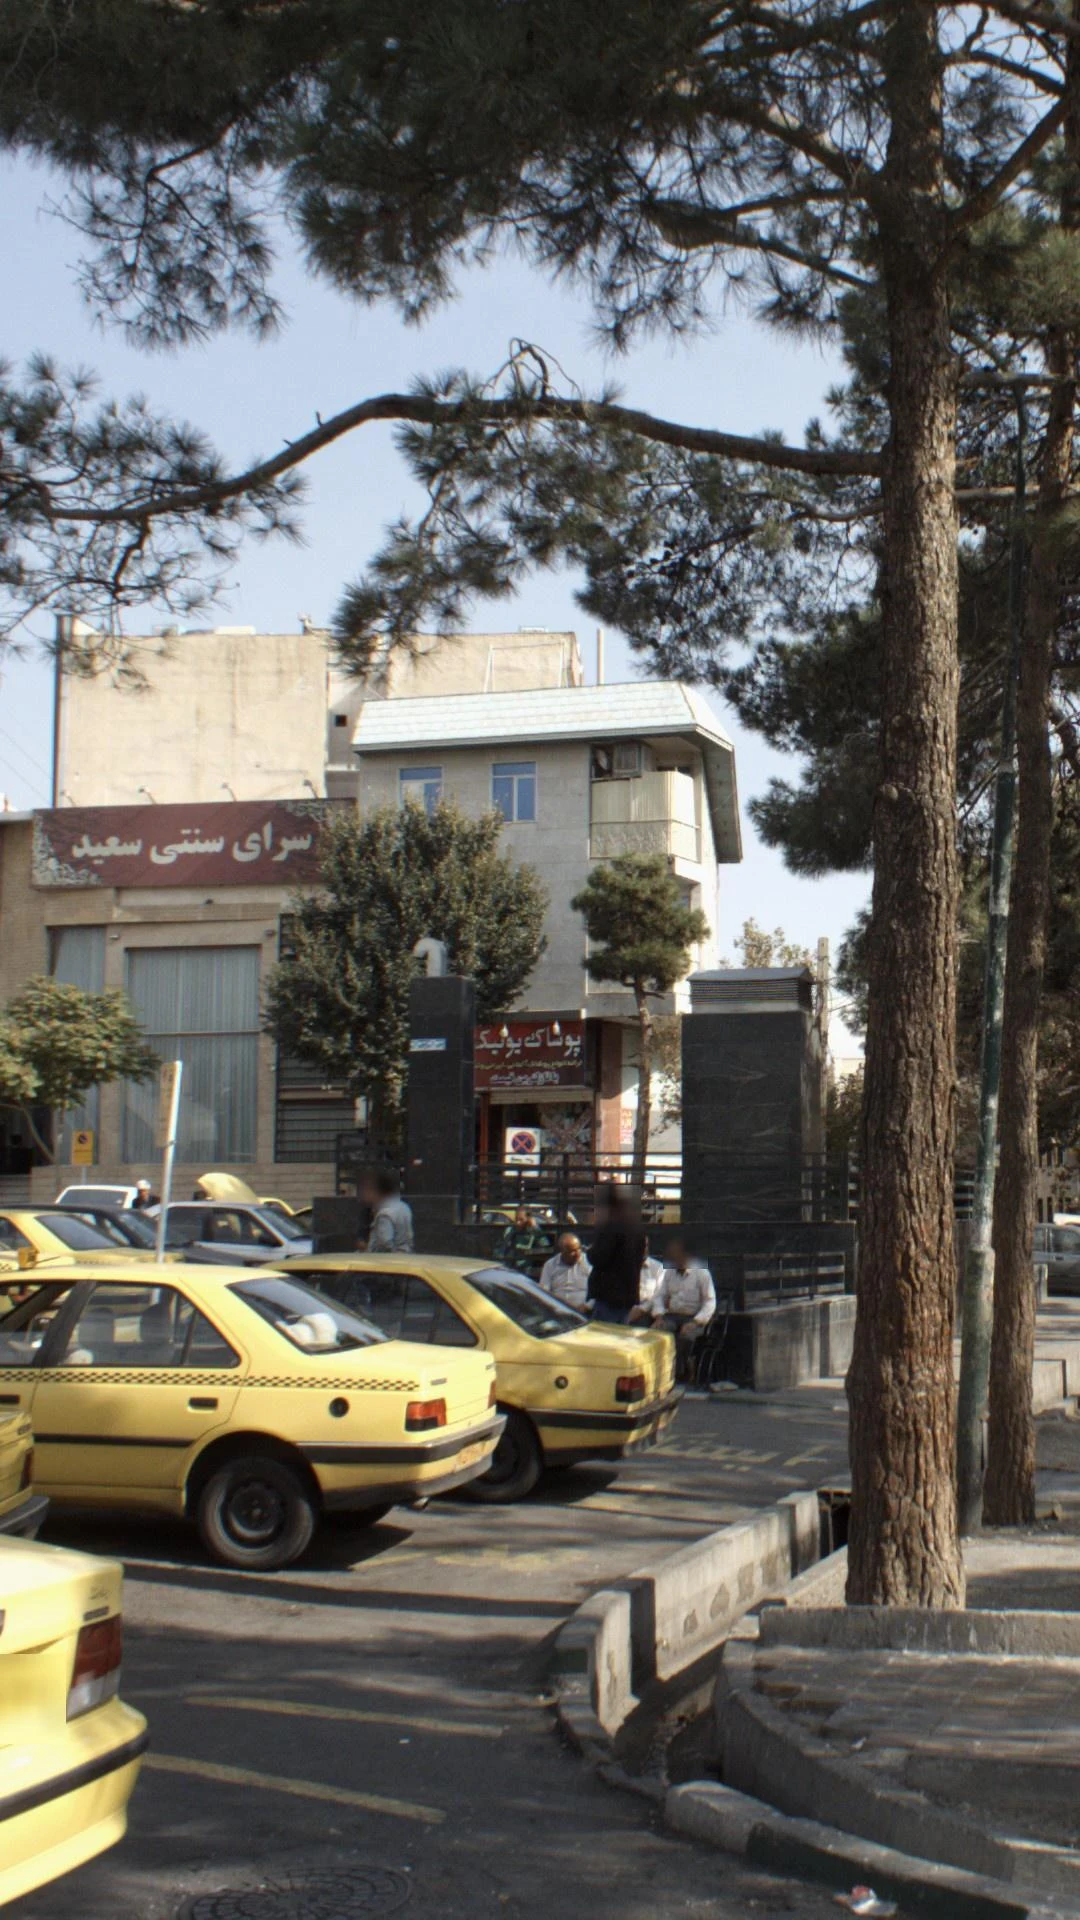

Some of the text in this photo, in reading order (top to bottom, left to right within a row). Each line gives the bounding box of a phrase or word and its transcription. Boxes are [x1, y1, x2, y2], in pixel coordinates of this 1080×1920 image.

[71, 821, 313, 865] سرای سنتی سعید
